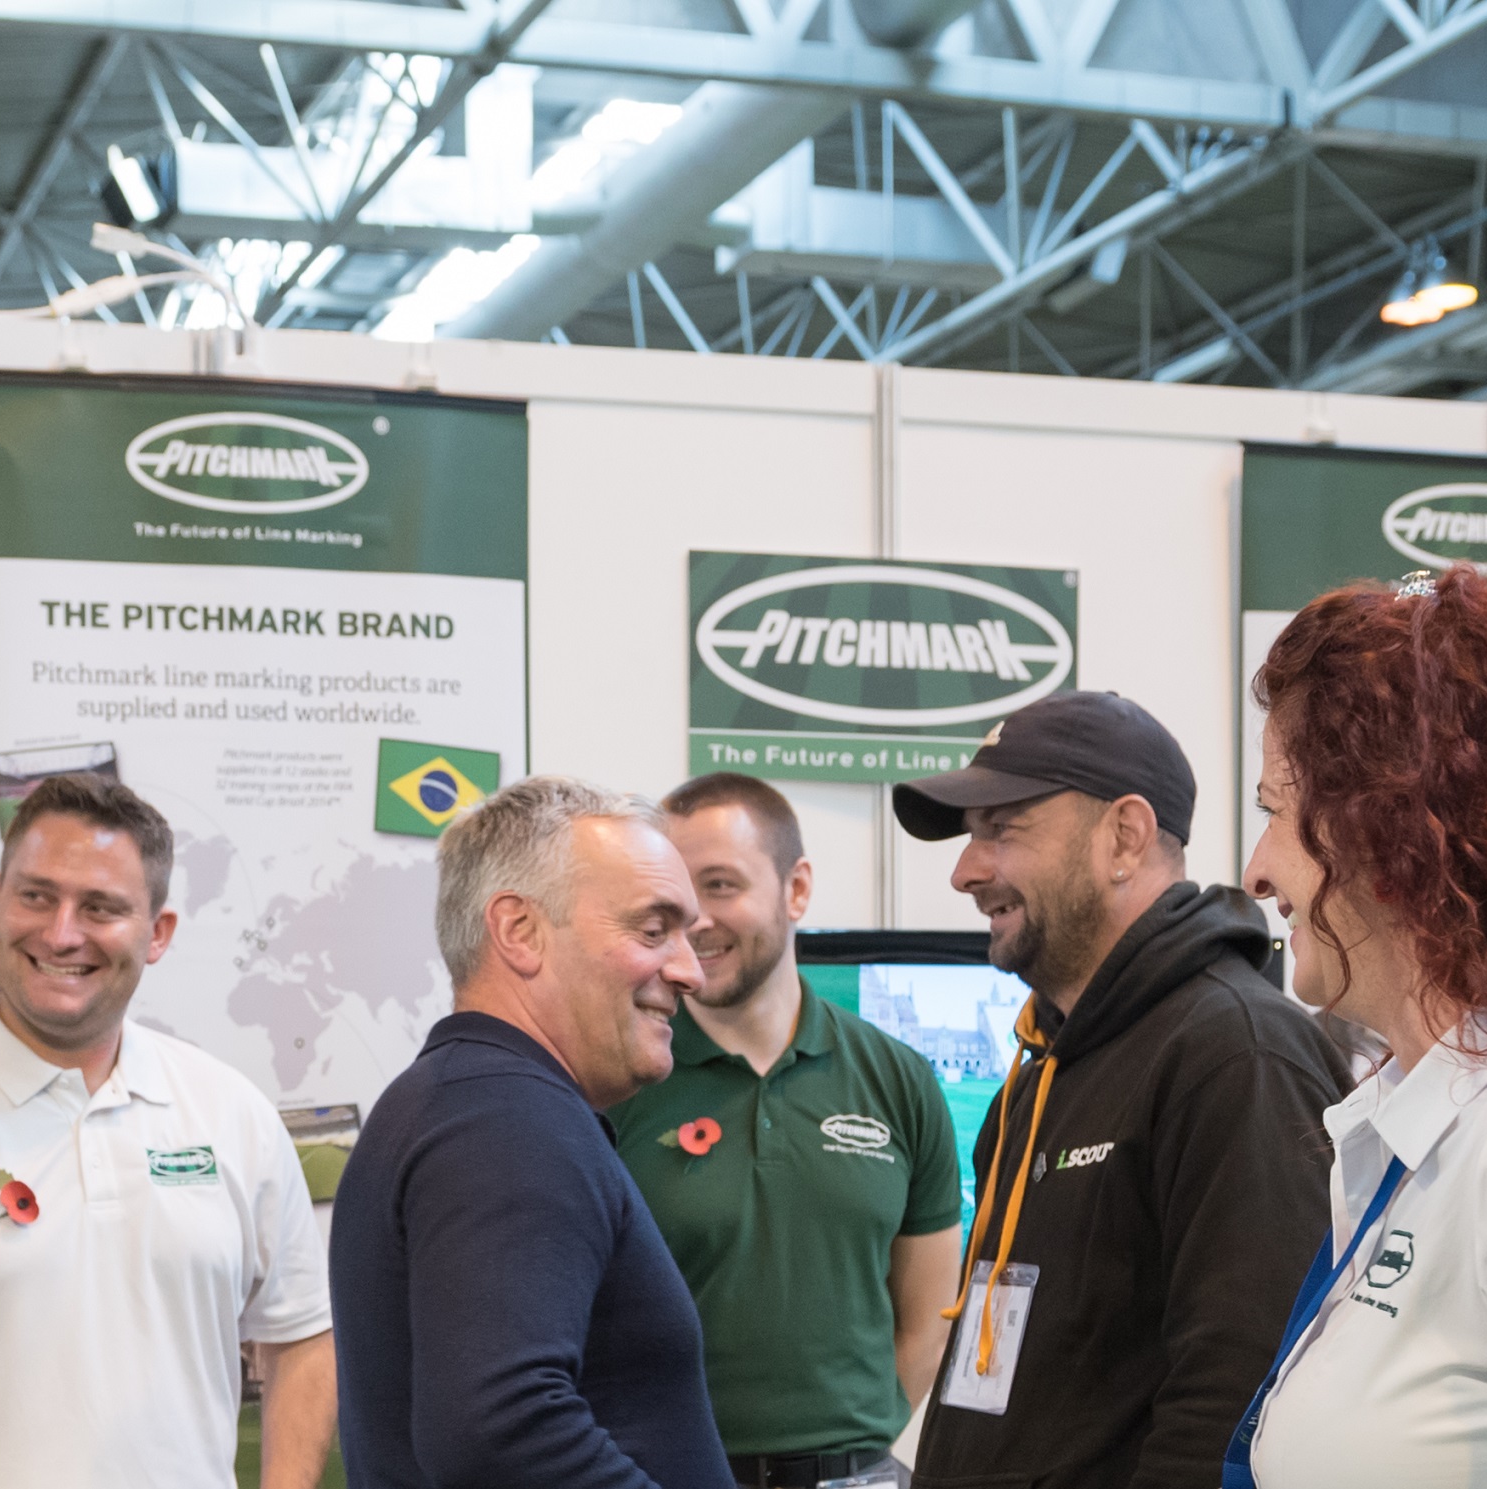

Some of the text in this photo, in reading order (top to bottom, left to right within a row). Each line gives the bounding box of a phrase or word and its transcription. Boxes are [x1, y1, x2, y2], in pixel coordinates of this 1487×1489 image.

[154, 440, 343, 487] PITCHMARK
[134, 522, 362, 548] The Future of Line Marking
[41, 601, 455, 640] THE PITCHMARK BRAND
[739, 608, 1032, 682] PITCHMARK
[31, 661, 462, 699] Pitchmark line marking products are
[77, 697, 421, 726] supplied and used worldwide.
[708, 743, 756, 764] The
[765, 745, 854, 768] Future
[862, 749, 888, 768] of
[897, 750, 952, 771] Line
